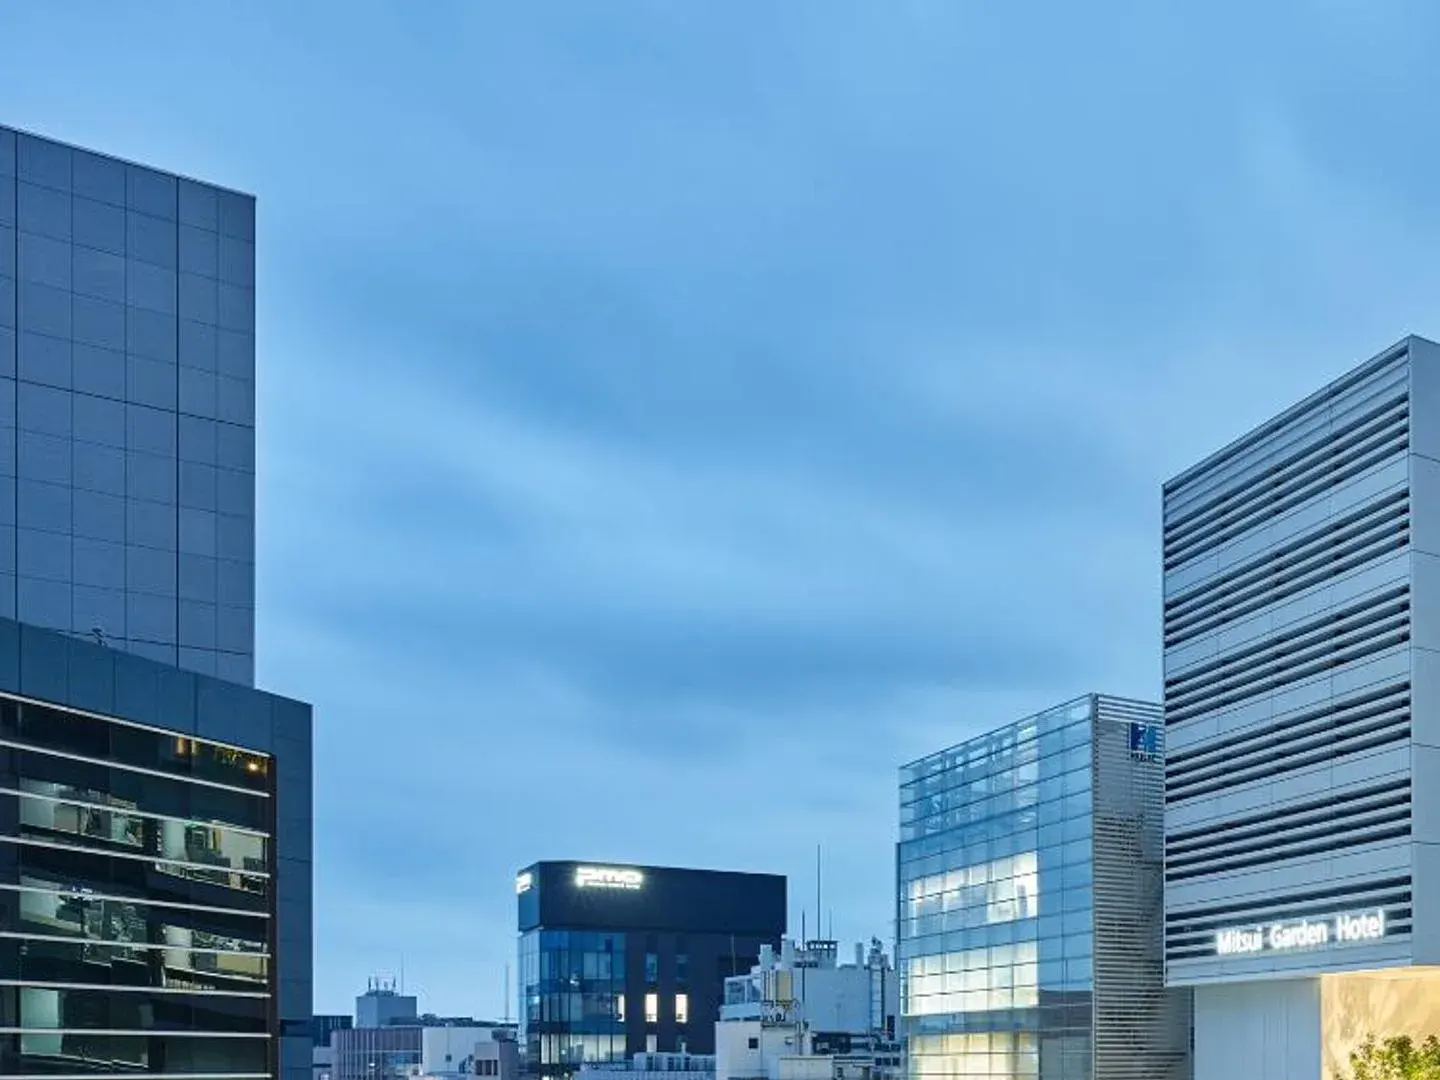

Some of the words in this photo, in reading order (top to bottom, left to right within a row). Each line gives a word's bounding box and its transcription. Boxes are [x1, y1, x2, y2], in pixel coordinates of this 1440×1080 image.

[1217, 926, 1262, 954] Mitsui
[1270, 919, 1327, 949] Garden
[1337, 909, 1384, 940] Hotel
